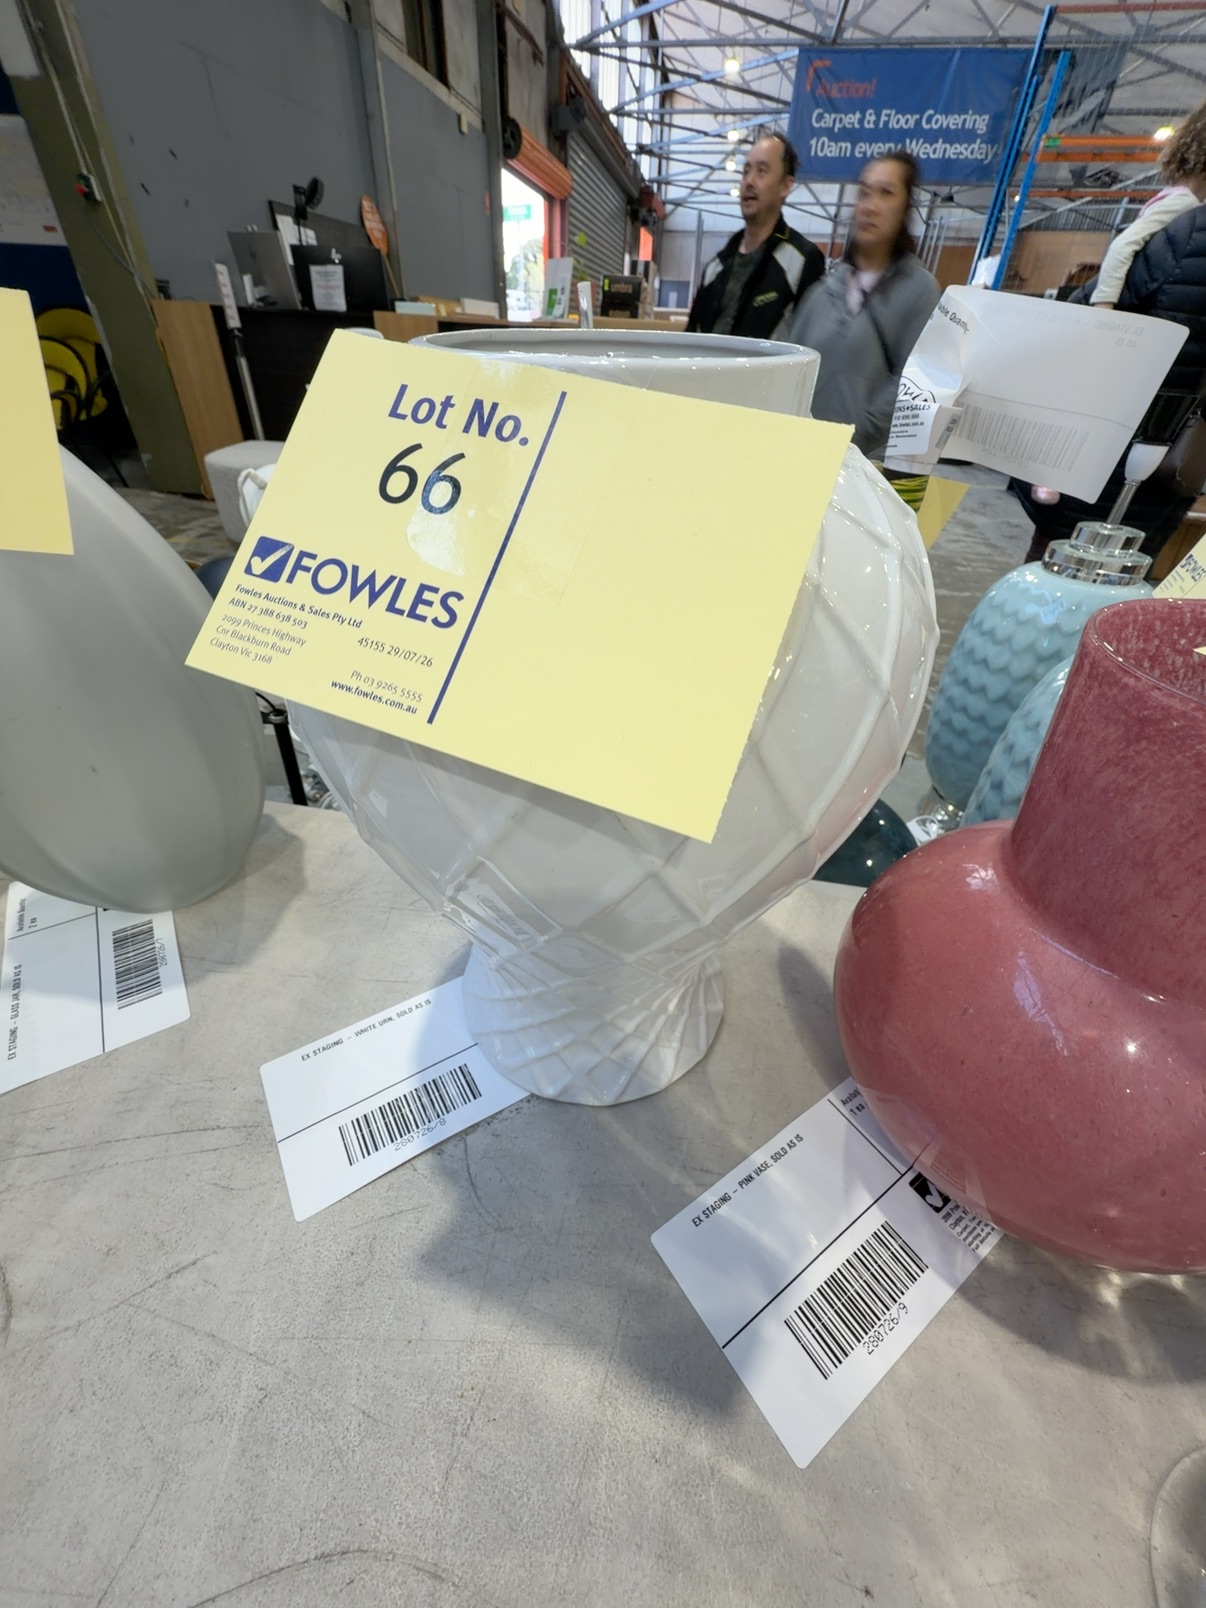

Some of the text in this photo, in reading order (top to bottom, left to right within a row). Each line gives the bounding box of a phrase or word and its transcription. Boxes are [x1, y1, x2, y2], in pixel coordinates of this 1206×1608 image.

[815, 78, 877, 98] Auction!
[811, 108, 989, 134] Carpet & Floor Covering
[809, 136, 851, 158] 10am
[905, 138, 997, 165] Wednesday
[388, 384, 529, 446] Lot No.
[379, 443, 466, 515] 66
[285, 550, 464, 629] FOWLES
[229, 597, 308, 629] ABN 27 388 638 503
[235, 584, 363, 628] Fowles Auctions & Sales Pty Ltd
[215, 625, 292, 656] Cnr Blackburn Road
[221, 614, 307, 647] 2099 Princes Highway
[210, 637, 273, 665] Clayton Vic 3168
[357, 637, 433, 668] 45155 29/07/26
[331, 679, 418, 715] www.fowles.com.au
[350, 670, 424, 703] Ph 03 9265 5555
[12, 976, 22, 991] SOLD
[14, 969, 22, 978] AS
[10, 1001, 20, 1021] GLASS
[8, 1026, 18, 1052] STAGING
[301, 1053, 312, 1062] EX
[312, 1038, 344, 1057] STAGING
[354, 1023, 377, 1037] WHITE
[396, 1007, 413, 1019] SOLD
[415, 1002, 425, 1011] AS
[424, 998, 432, 1006] IS
[7, 1051, 17, 1061] EX
[849, 1102, 866, 1117] 1 ea
[392, 1117, 447, 1152] 280726/8
[691, 1214, 704, 1228] EX
[702, 1191, 733, 1220] STAGING
[737, 1174, 756, 1191] PINK
[753, 1158, 774, 1179] VASE,
[770, 1147, 788, 1165] SOLD
[785, 1138, 798, 1152] AS
[795, 1133, 805, 1144] IS
[861, 1301, 910, 1356] 280726/9
